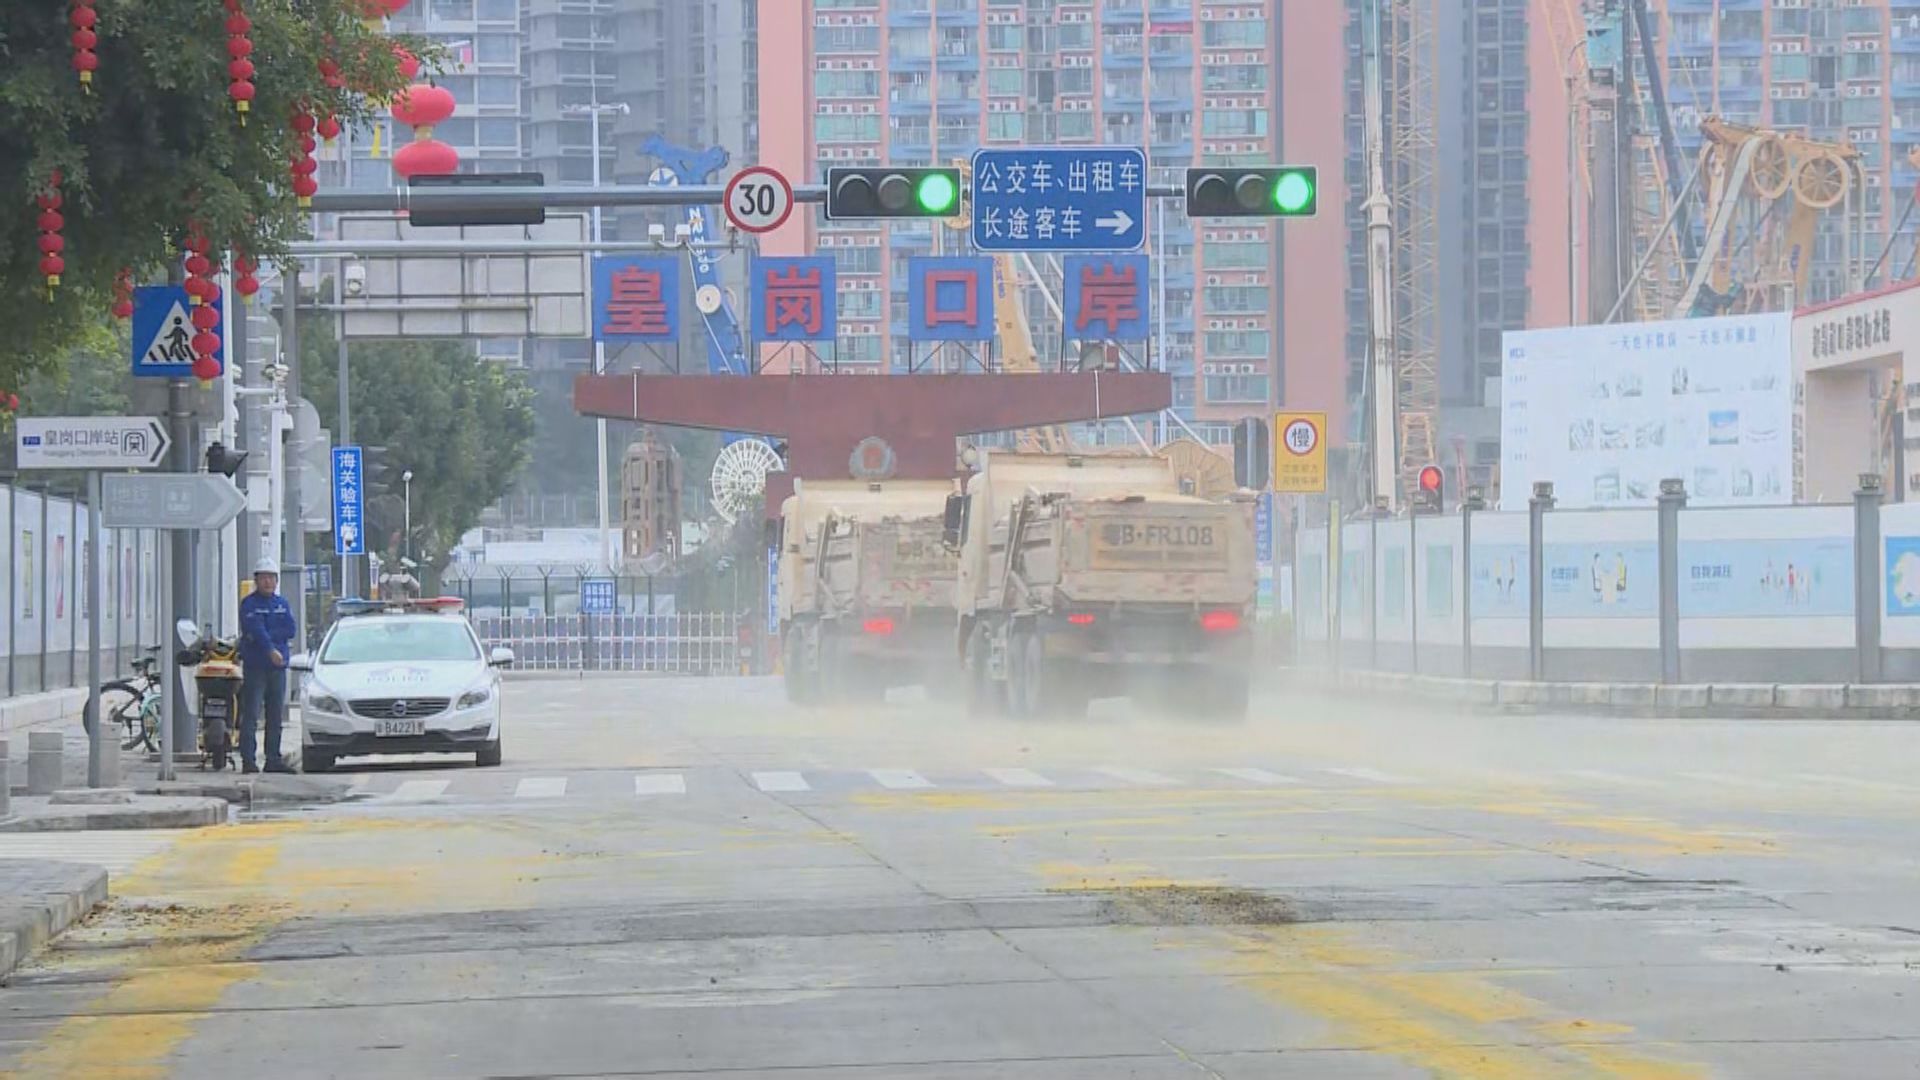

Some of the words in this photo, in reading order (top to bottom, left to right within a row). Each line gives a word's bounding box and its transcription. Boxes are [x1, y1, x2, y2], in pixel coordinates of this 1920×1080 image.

[979, 159, 1139, 194] 公交车、出租车
[738, 183, 775, 216] 30
[981, 205, 1082, 240] 长途客车
[602, 264, 1139, 335] 皇岗口岸
[45, 429, 119, 446] 皇岗口岸站
[1291, 427, 1310, 447] 慢
